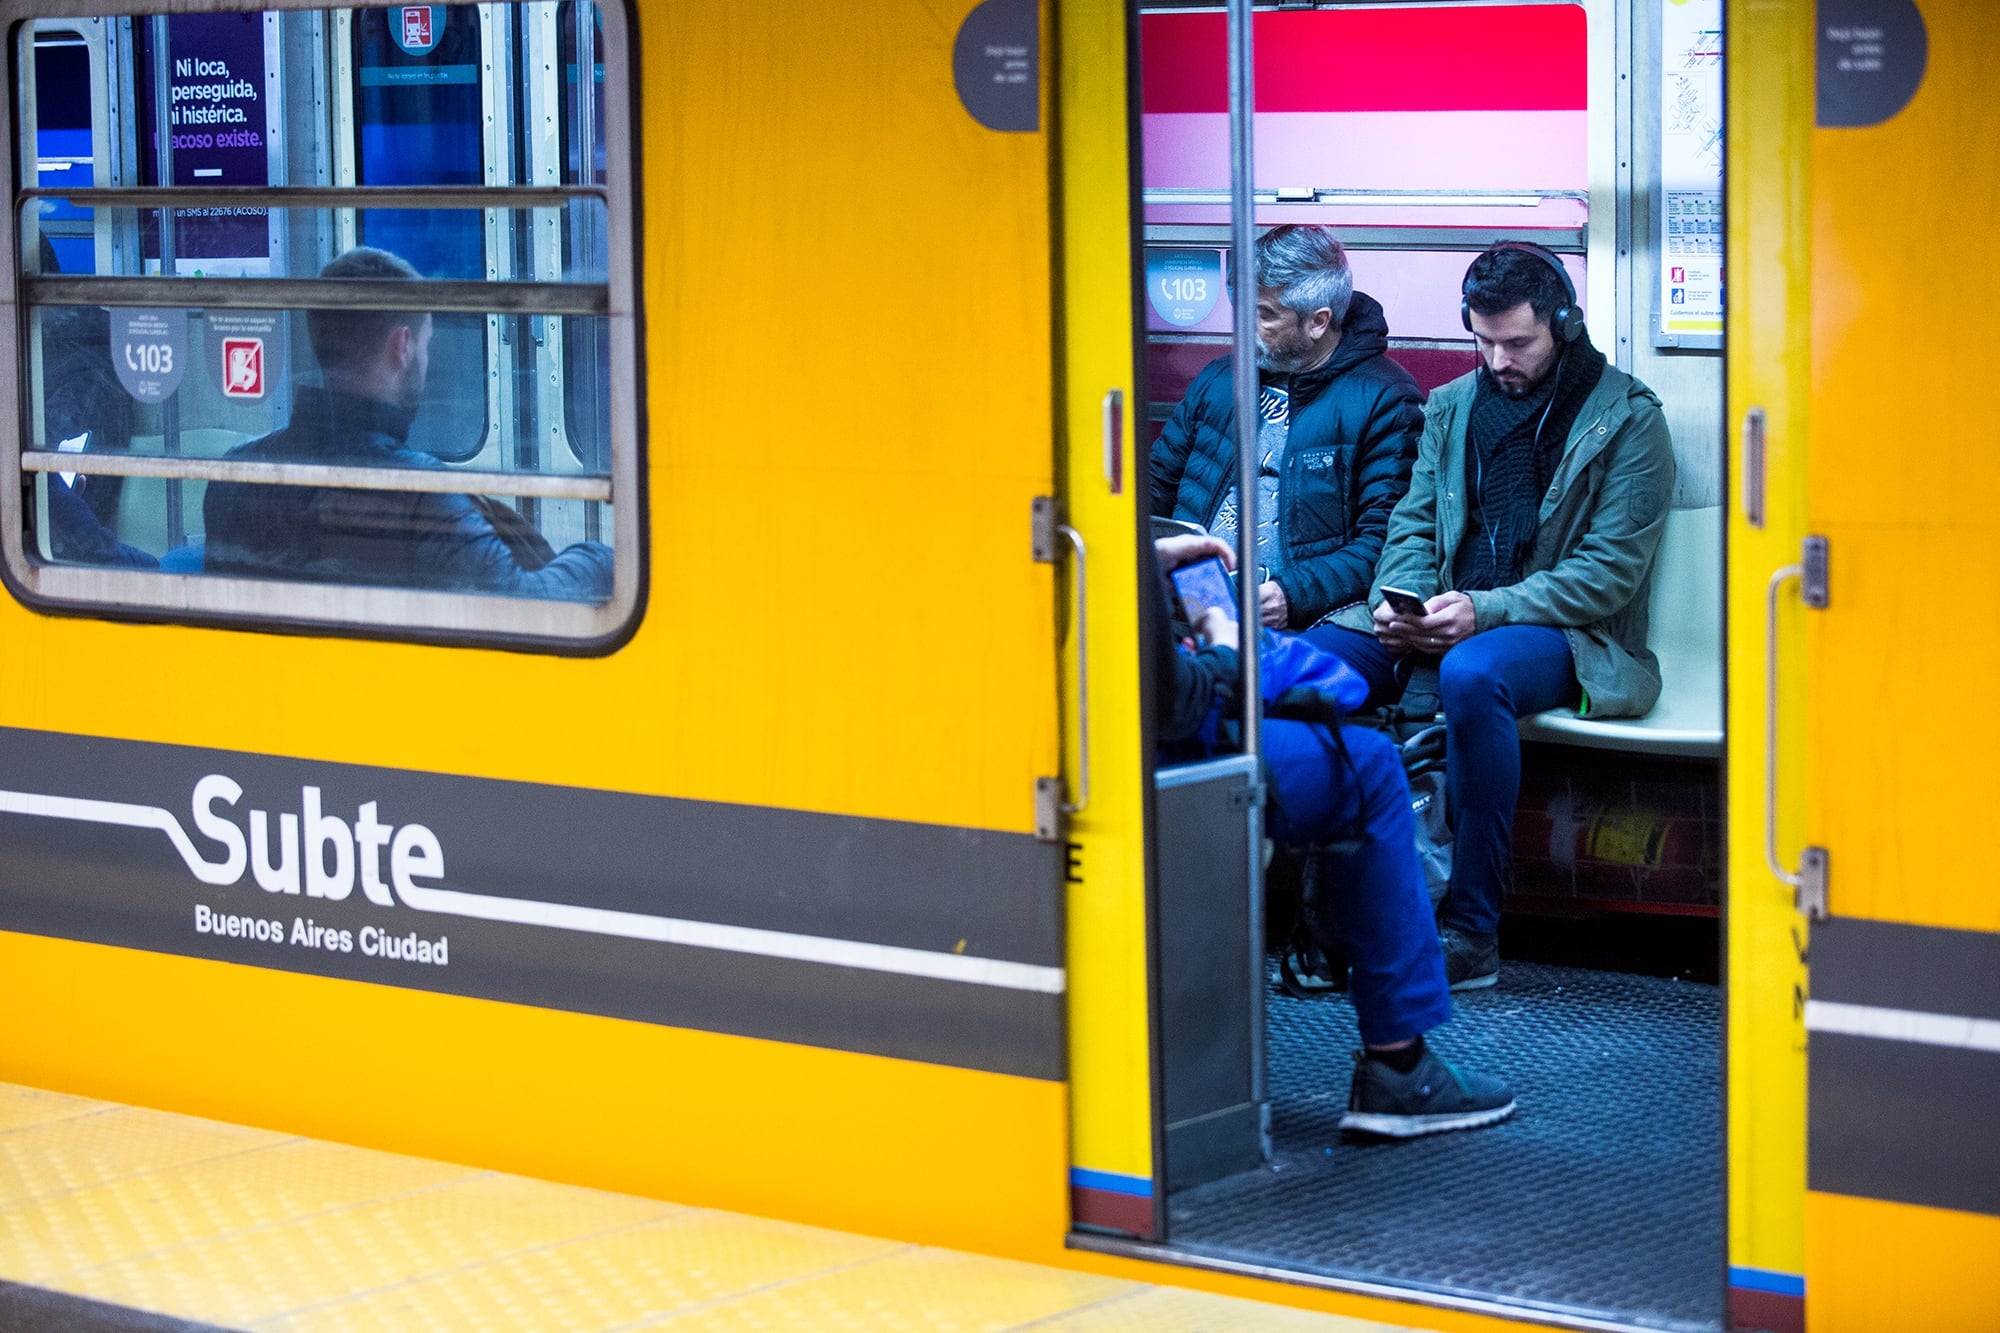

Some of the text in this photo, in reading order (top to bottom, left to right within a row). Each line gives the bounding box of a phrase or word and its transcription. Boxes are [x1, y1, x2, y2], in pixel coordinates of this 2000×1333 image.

[176, 57, 230, 79] Ni loca,
[171, 79, 257, 104] perseguida,
[182, 104, 248, 124] histérica.
[172, 133, 213, 149] acoso
[216, 128, 263, 148] existe.
[176, 209, 187, 217] un
[187, 207, 202, 217] SMS
[202, 207, 209, 216] al
[210, 206, 232, 216] 22676
[1172, 278, 1207, 301] 103
[136, 344, 173, 374] 103
[192, 774, 445, 911] Subte
[195, 904, 449, 966] Buenos Aires Ciudad
